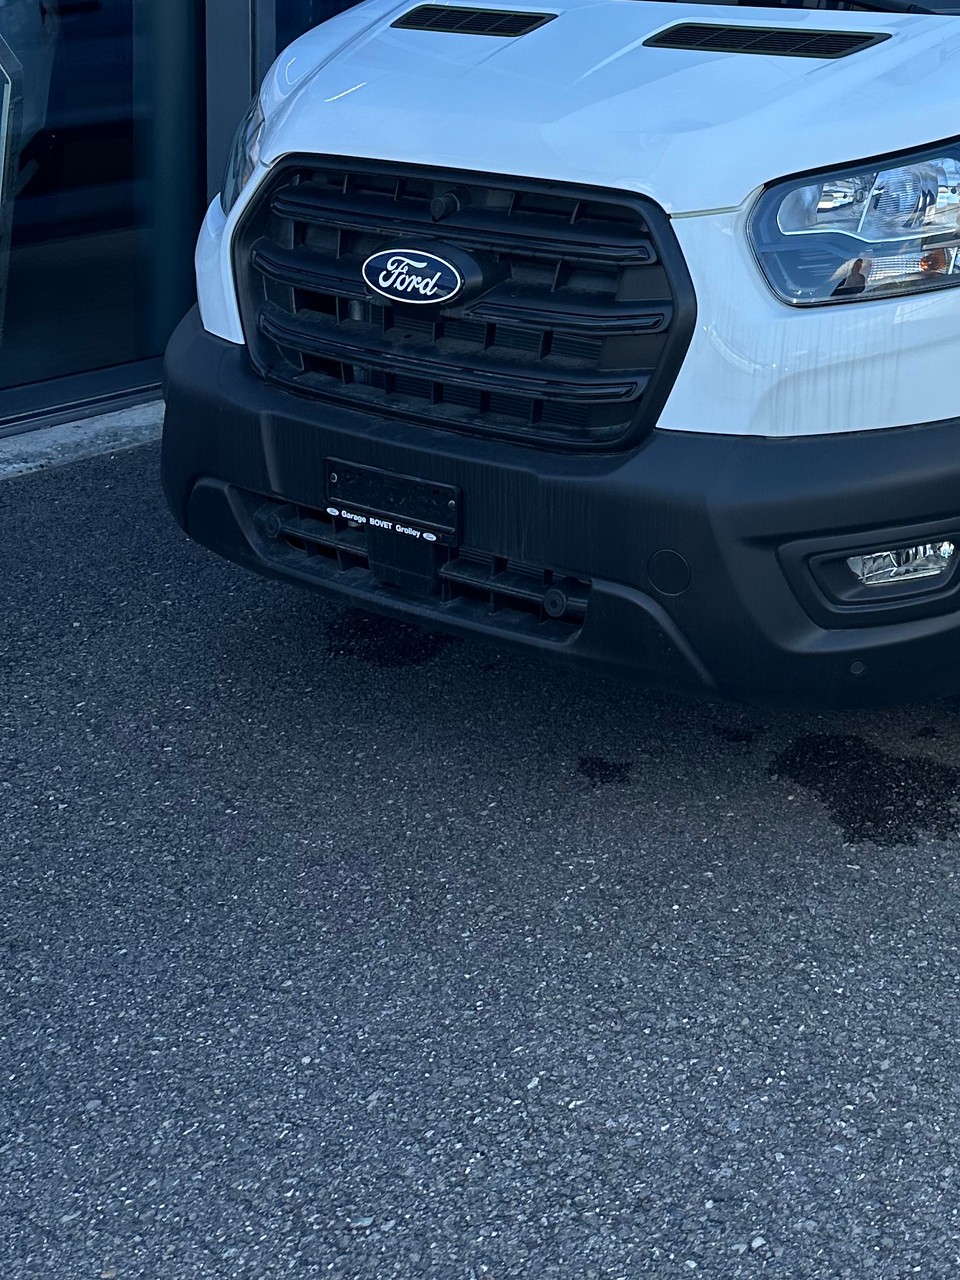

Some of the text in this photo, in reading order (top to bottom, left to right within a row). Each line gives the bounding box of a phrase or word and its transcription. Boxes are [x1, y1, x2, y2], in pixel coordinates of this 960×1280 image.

[379, 256, 442, 296] Ford
[341, 510, 367, 523] Garage
[369, 517, 393, 530] BOVET
[395, 524, 421, 538] Grolley
